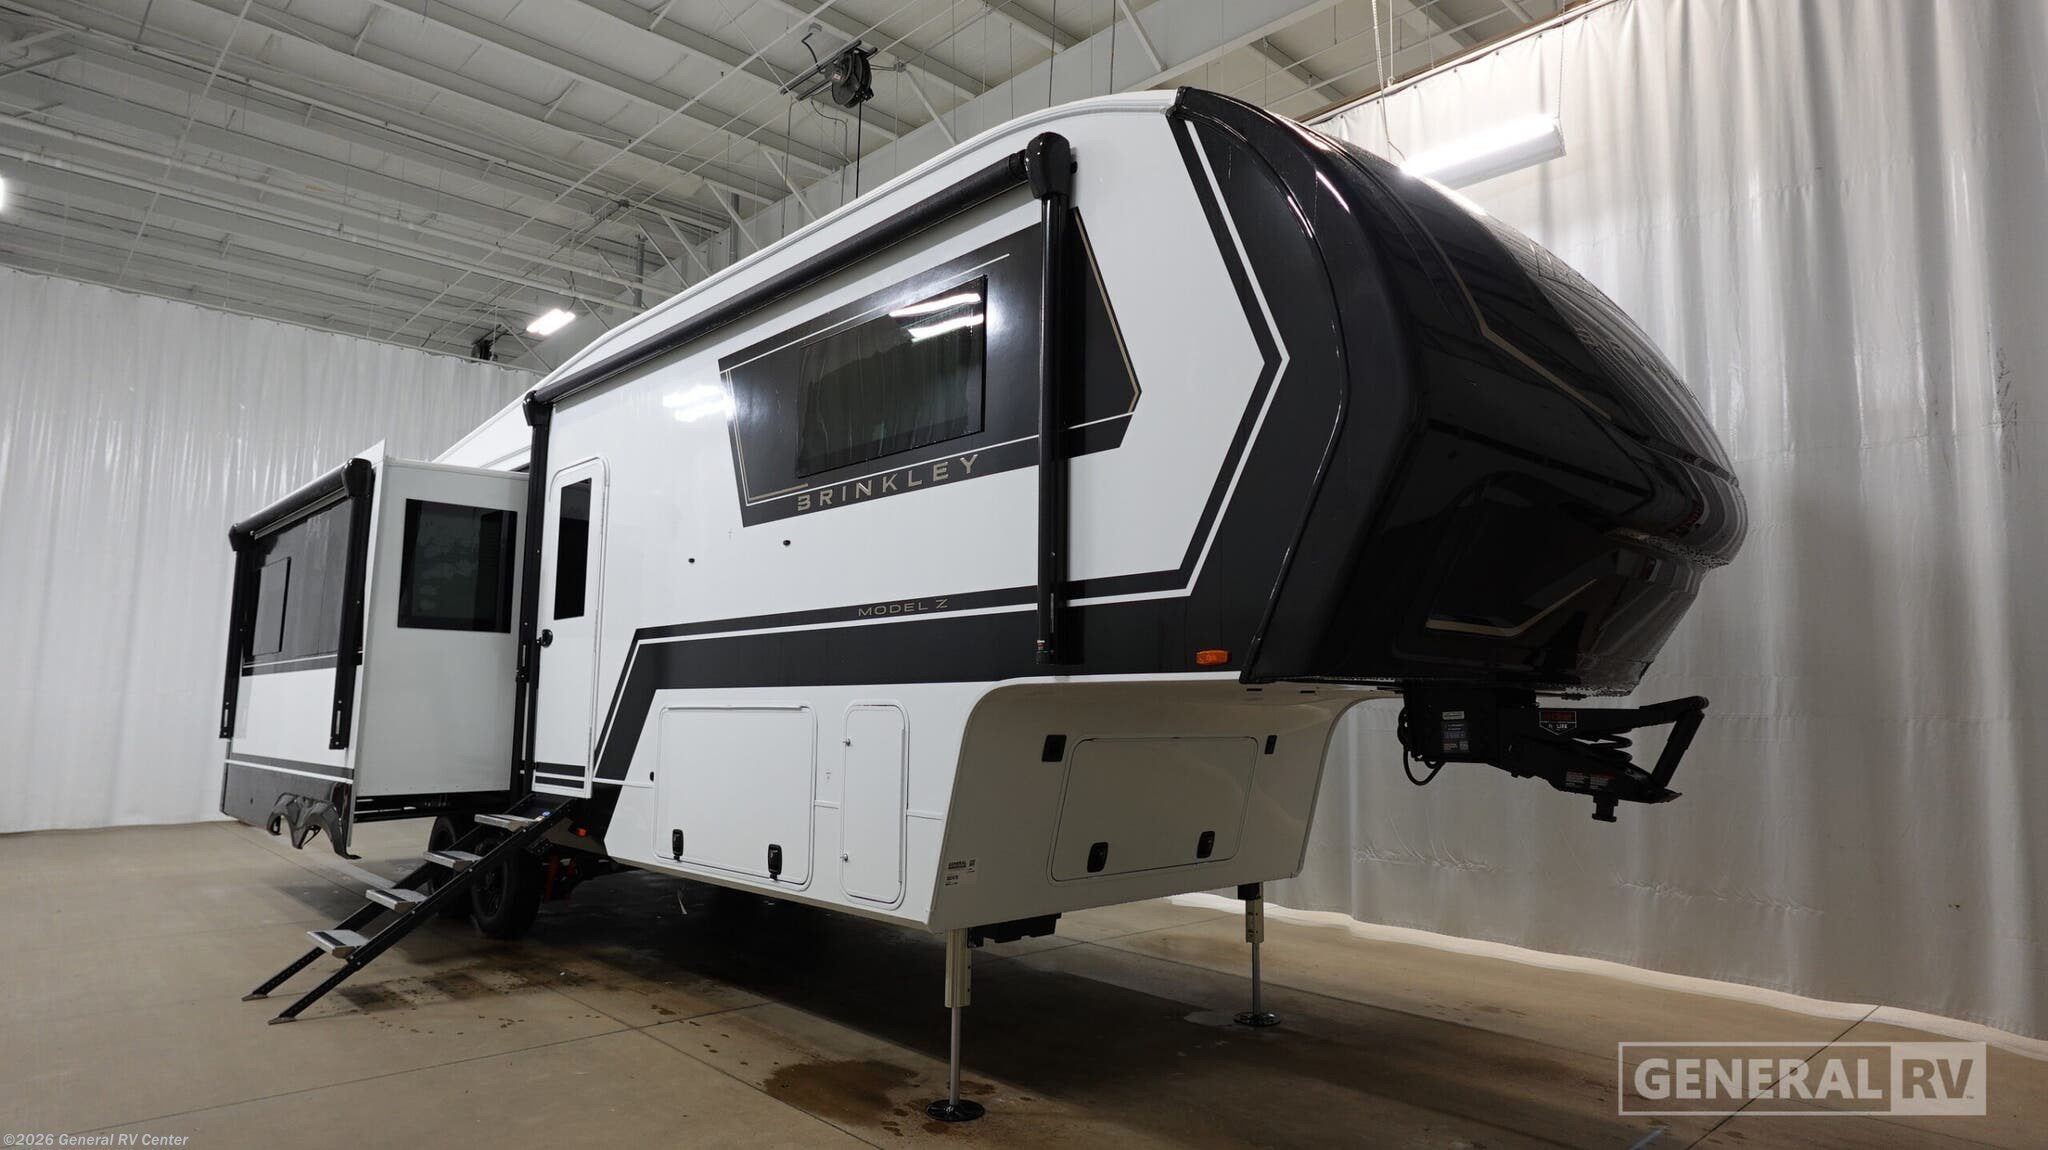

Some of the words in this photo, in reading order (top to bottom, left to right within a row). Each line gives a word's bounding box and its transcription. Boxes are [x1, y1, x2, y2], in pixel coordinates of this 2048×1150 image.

[797, 454, 978, 511] BRINKLEY
[858, 602, 928, 617] MODEL
[935, 599, 948, 609] Z
